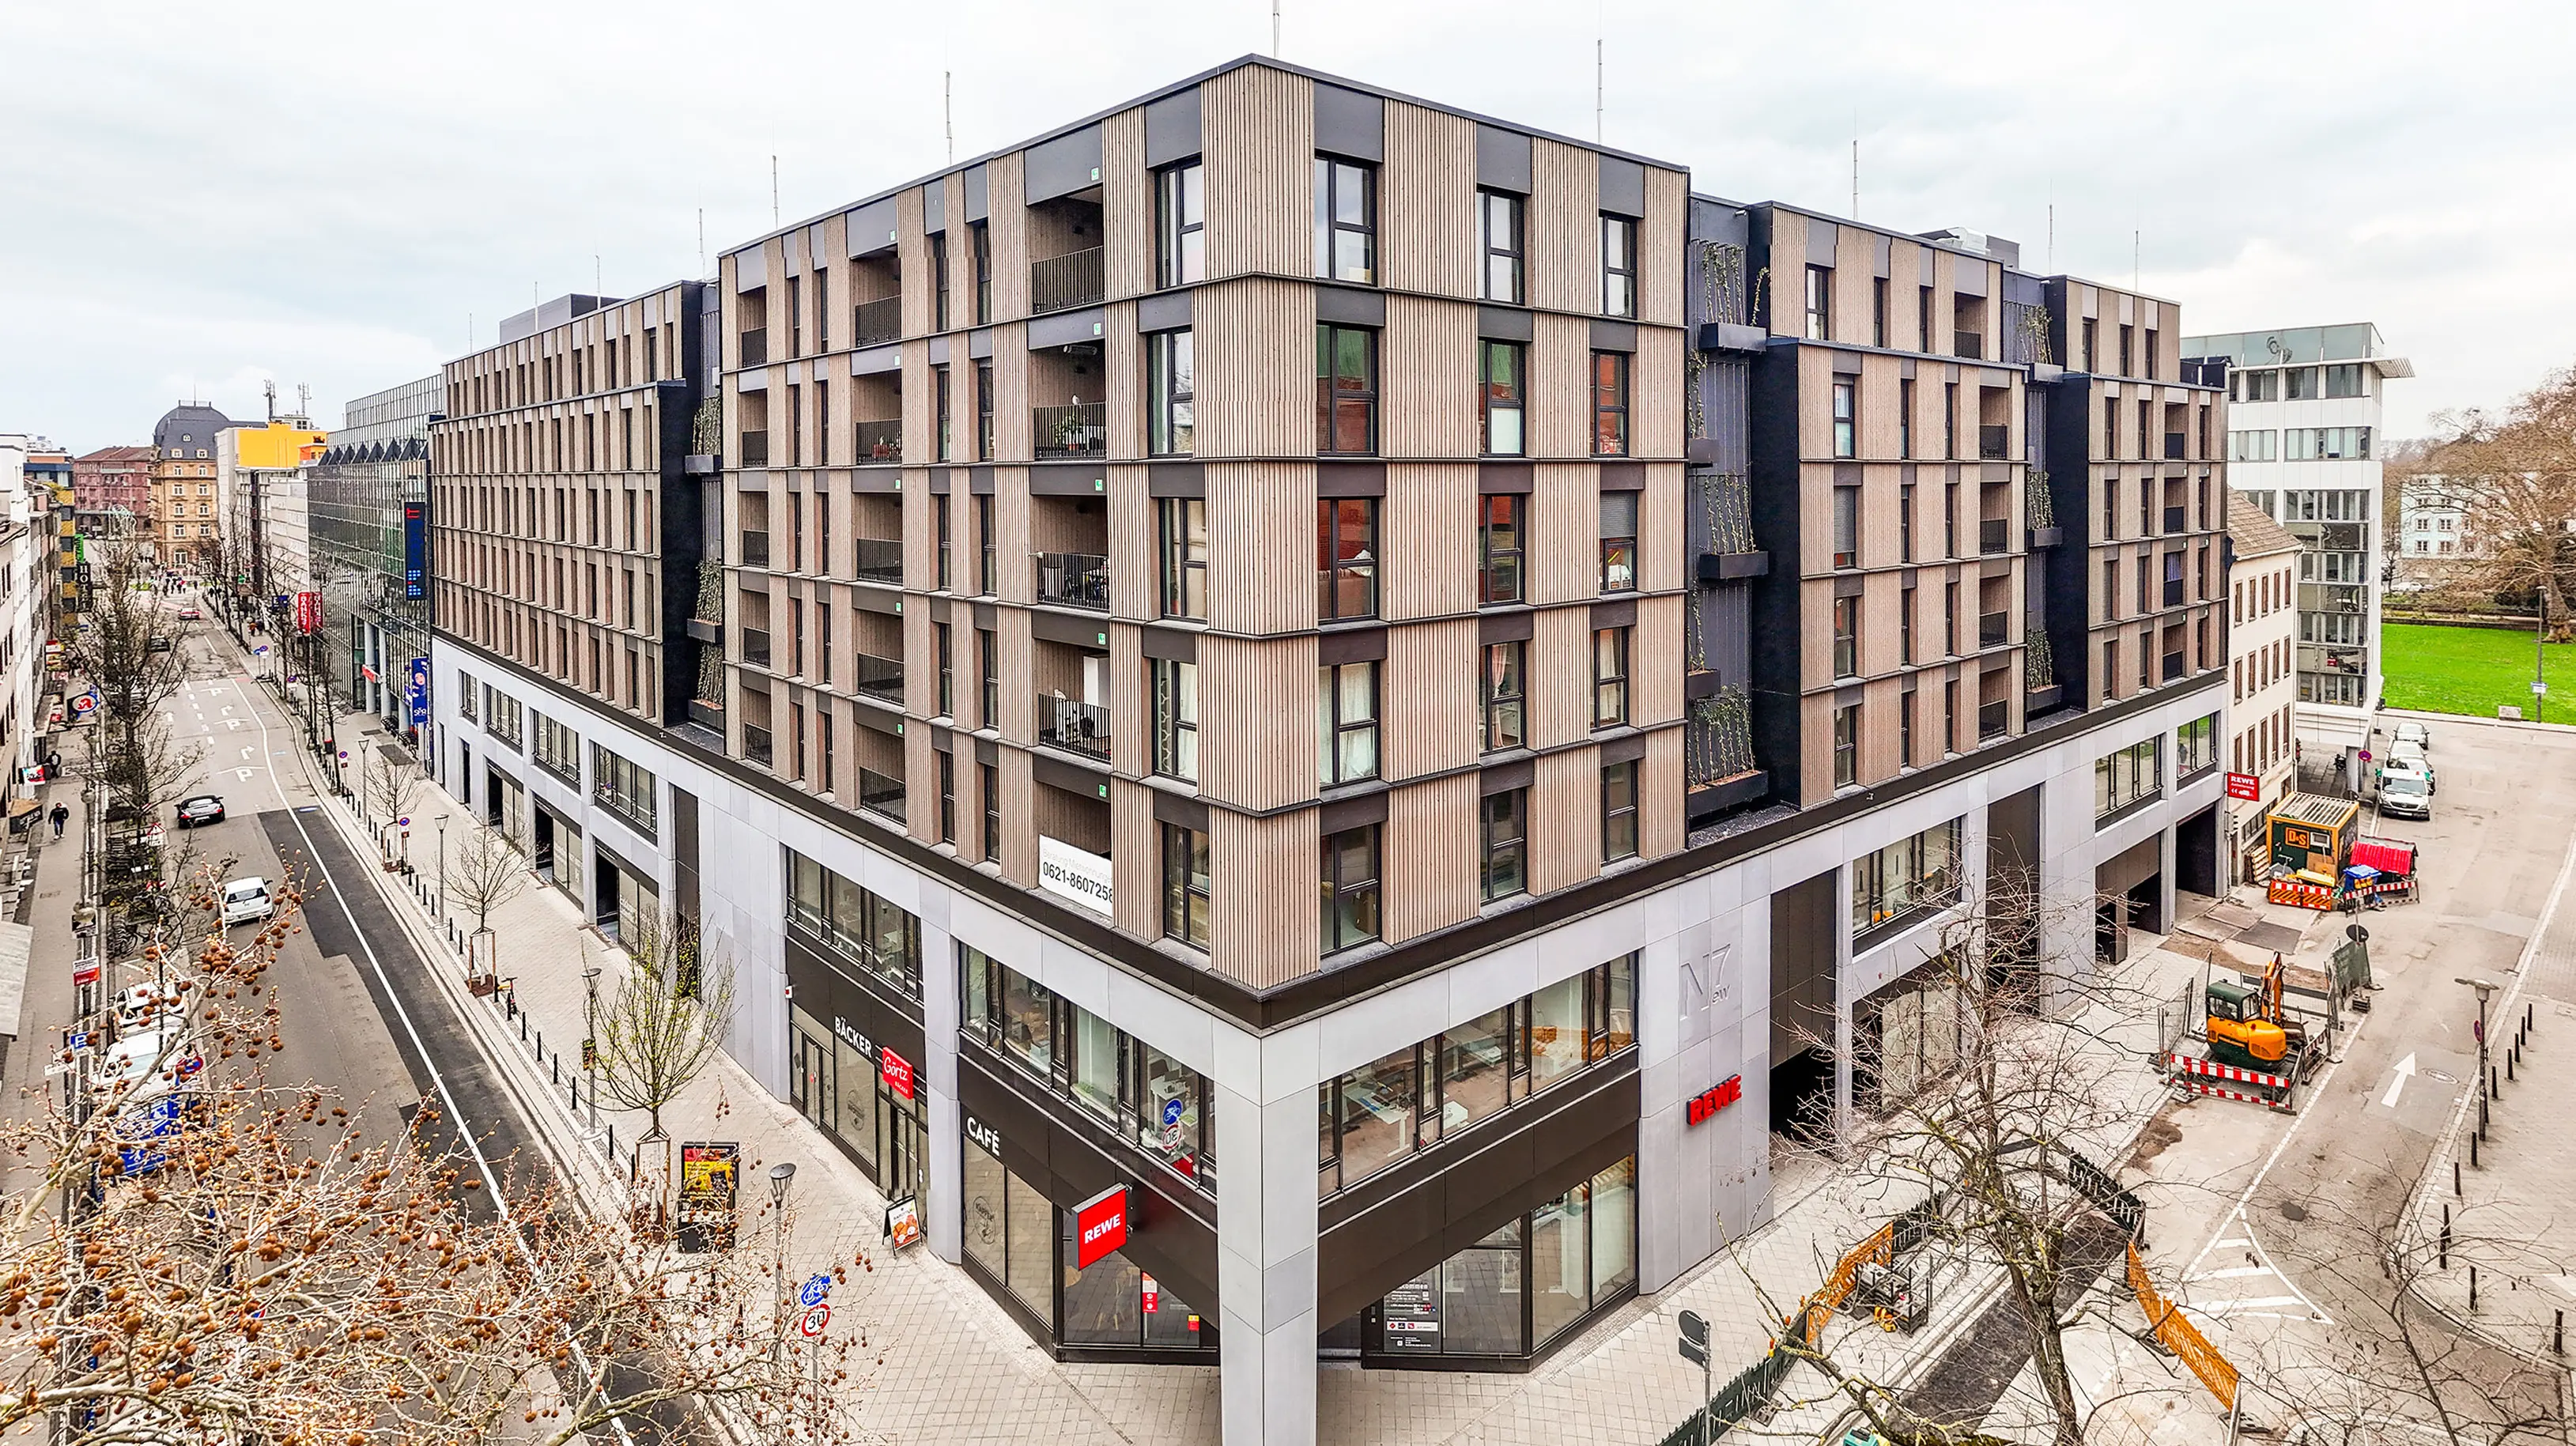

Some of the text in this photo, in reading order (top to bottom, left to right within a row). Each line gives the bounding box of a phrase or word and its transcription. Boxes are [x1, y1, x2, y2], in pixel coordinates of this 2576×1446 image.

[2230, 776, 2255, 786] REWE
[74, 1034, 87, 1048] P
[835, 1015, 872, 1059] BÄCKER
[883, 1056, 908, 1082] Görtz
[1686, 1074, 1743, 1127] REWE
[967, 1116, 1000, 1157] CAFÉ
[1084, 1214, 1121, 1244] REWE
[808, 1311, 825, 1330] 30
